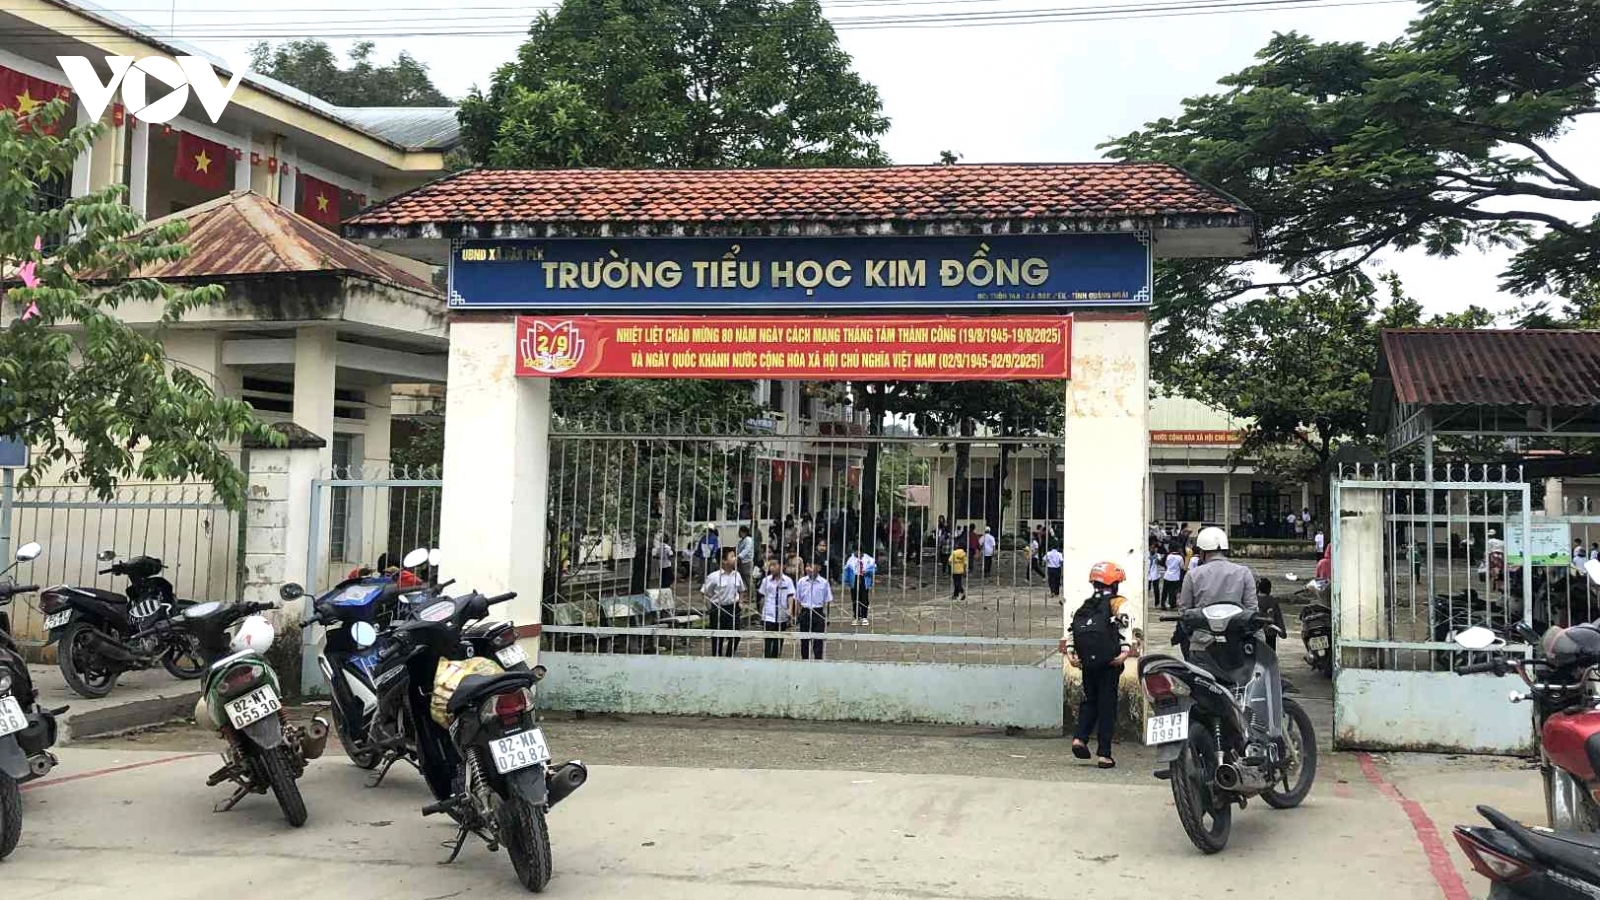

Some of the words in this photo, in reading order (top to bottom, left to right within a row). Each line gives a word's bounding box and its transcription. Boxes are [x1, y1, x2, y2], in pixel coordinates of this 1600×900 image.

[461, 248, 487, 261] UBND
[541, 249, 683, 289] TRƯỜNG
[692, 244, 760, 289] TIỂU
[771, 260, 852, 296] HỌC
[865, 259, 926, 287] KIM
[939, 242, 1049, 287] ĐỒNG
[537, 335, 568, 354] 2/9
[616, 325, 643, 346] NHIỆT
[645, 325, 664, 346] LIỆT
[665, 325, 690, 343] CHÀO
[692, 325, 720, 343] MỪNG
[721, 328, 733, 343] 80
[735, 325, 757, 343] NĂM
[759, 325, 784, 343] NGÀY
[786, 325, 810, 343] CÁCH
[813, 327, 840, 346] MẠNG
[842, 325, 873, 343] THÁNG
[876, 325, 896, 343] TÁM
[898, 325, 928, 343] THÀNH
[930, 325, 957, 343] CÔNG
[959, 327, 1061, 344] (19/8/1945-19/8/2025)
[631, 350, 644, 368] VÀ
[645, 350, 670, 368] NGÀY
[672, 348, 697, 370] QUỐC
[698, 350, 730, 368] KHÁNH
[732, 350, 757, 368] NƯỚC
[759, 350, 784, 371] CỘNG
[787, 350, 805, 368] HÒA
[808, 351, 821, 368] XÃ
[822, 350, 838, 371] HỘI
[840, 348, 859, 368] CHỦ
[861, 350, 891, 368] NGHĨA
[893, 350, 912, 371] VIỆT
[914, 353, 936, 368] NAM
[939, 353, 1044, 370] (02/9/1945-02/9/2025)!
[233, 690, 267, 713] 82-N1
[235, 699, 278, 727] 055.30
[1152, 713, 1182, 730] 29-V3
[1152, 726, 1181, 742] 0991
[498, 745, 548, 770] 029.82
